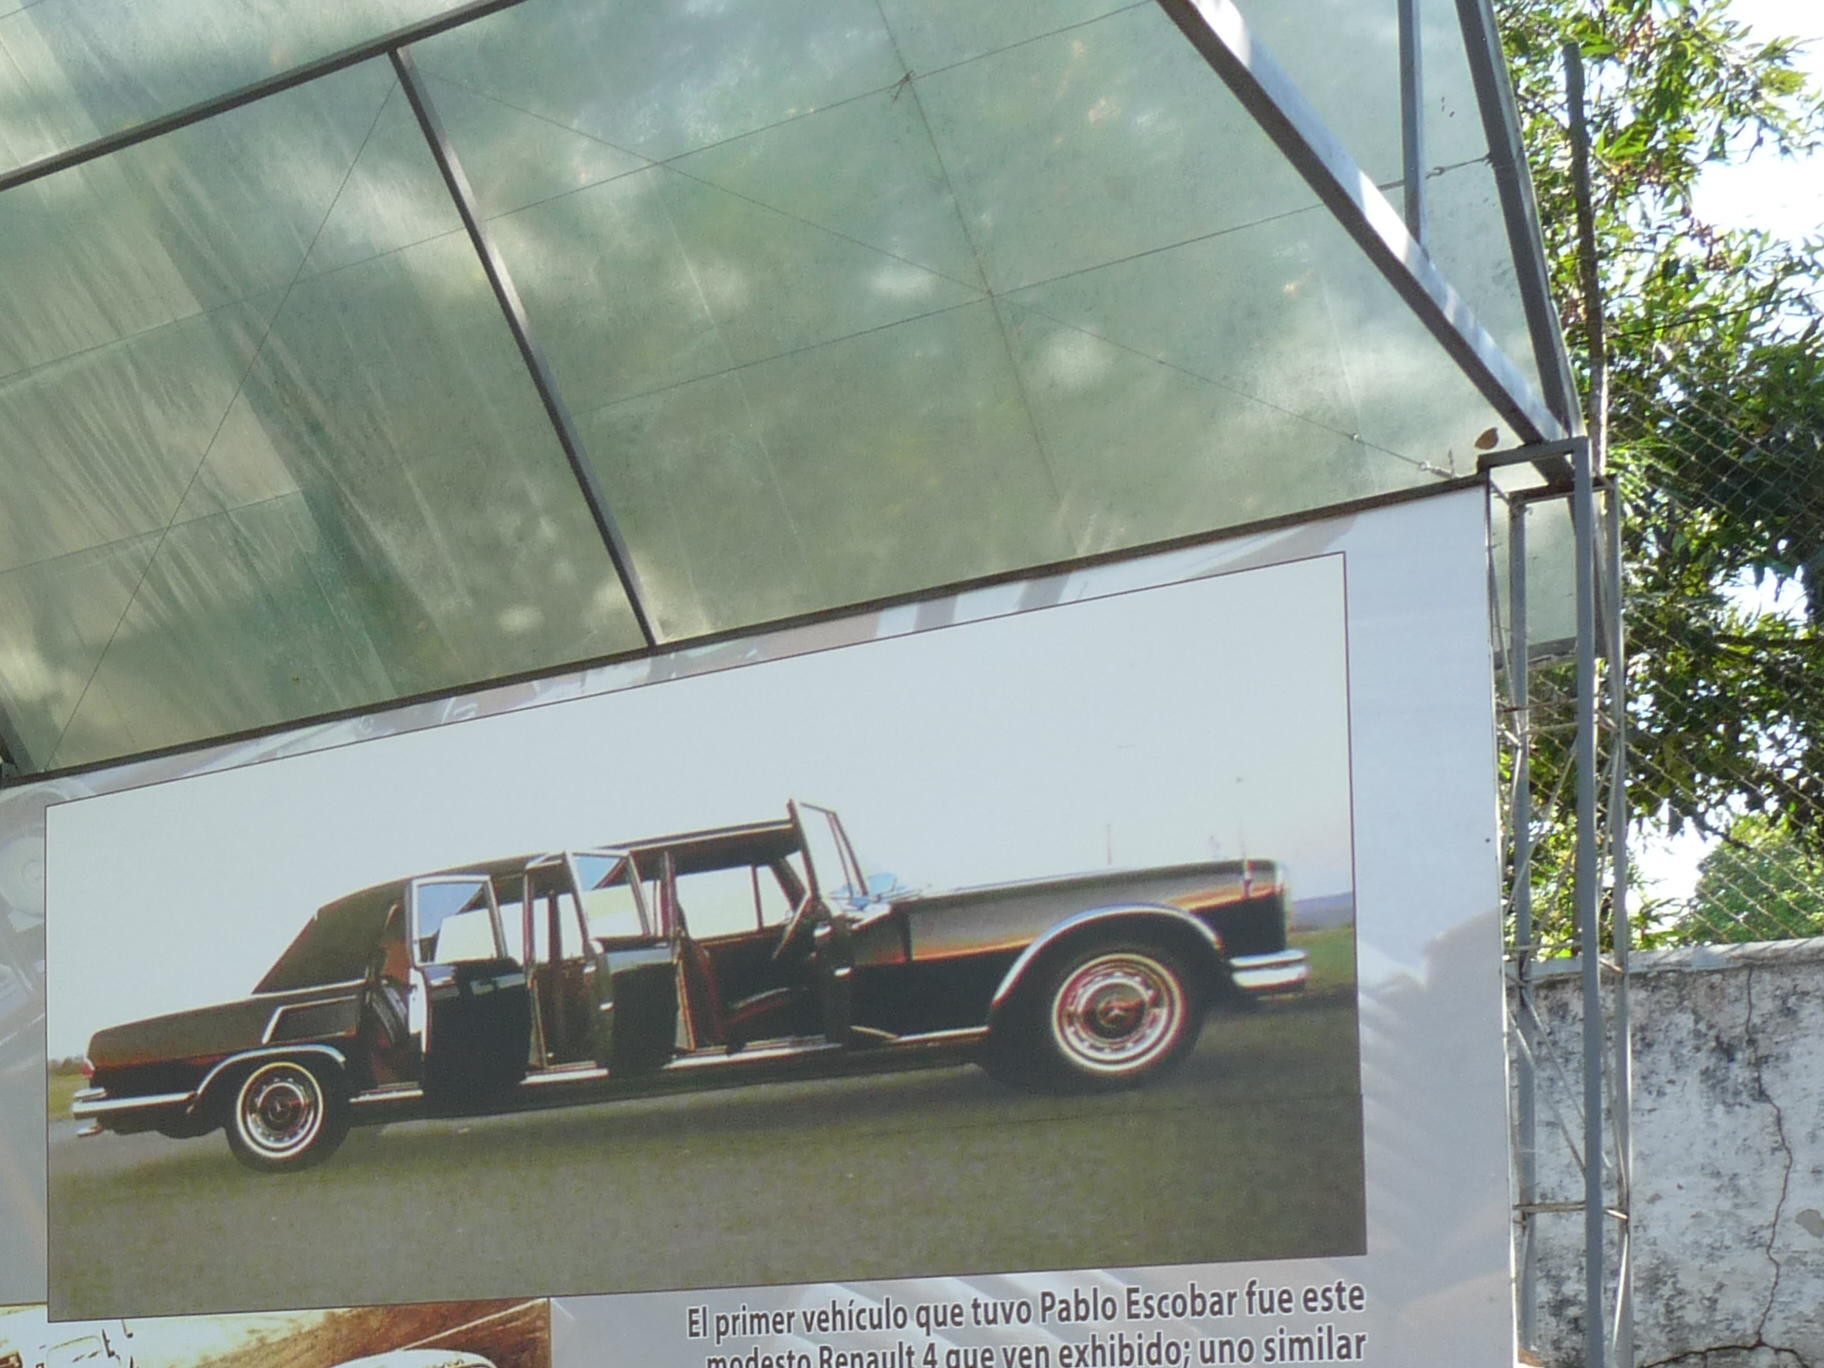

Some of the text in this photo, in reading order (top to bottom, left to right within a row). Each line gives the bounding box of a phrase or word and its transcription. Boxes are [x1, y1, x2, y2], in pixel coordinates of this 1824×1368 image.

[688, 1280, 1365, 1343] El primer vehículo que tuvo Pablo Escobar fue este
[1002, 1345, 1049, 1368] ven
[1200, 1337, 1254, 1363] uno
[1264, 1326, 1366, 1360] similar
